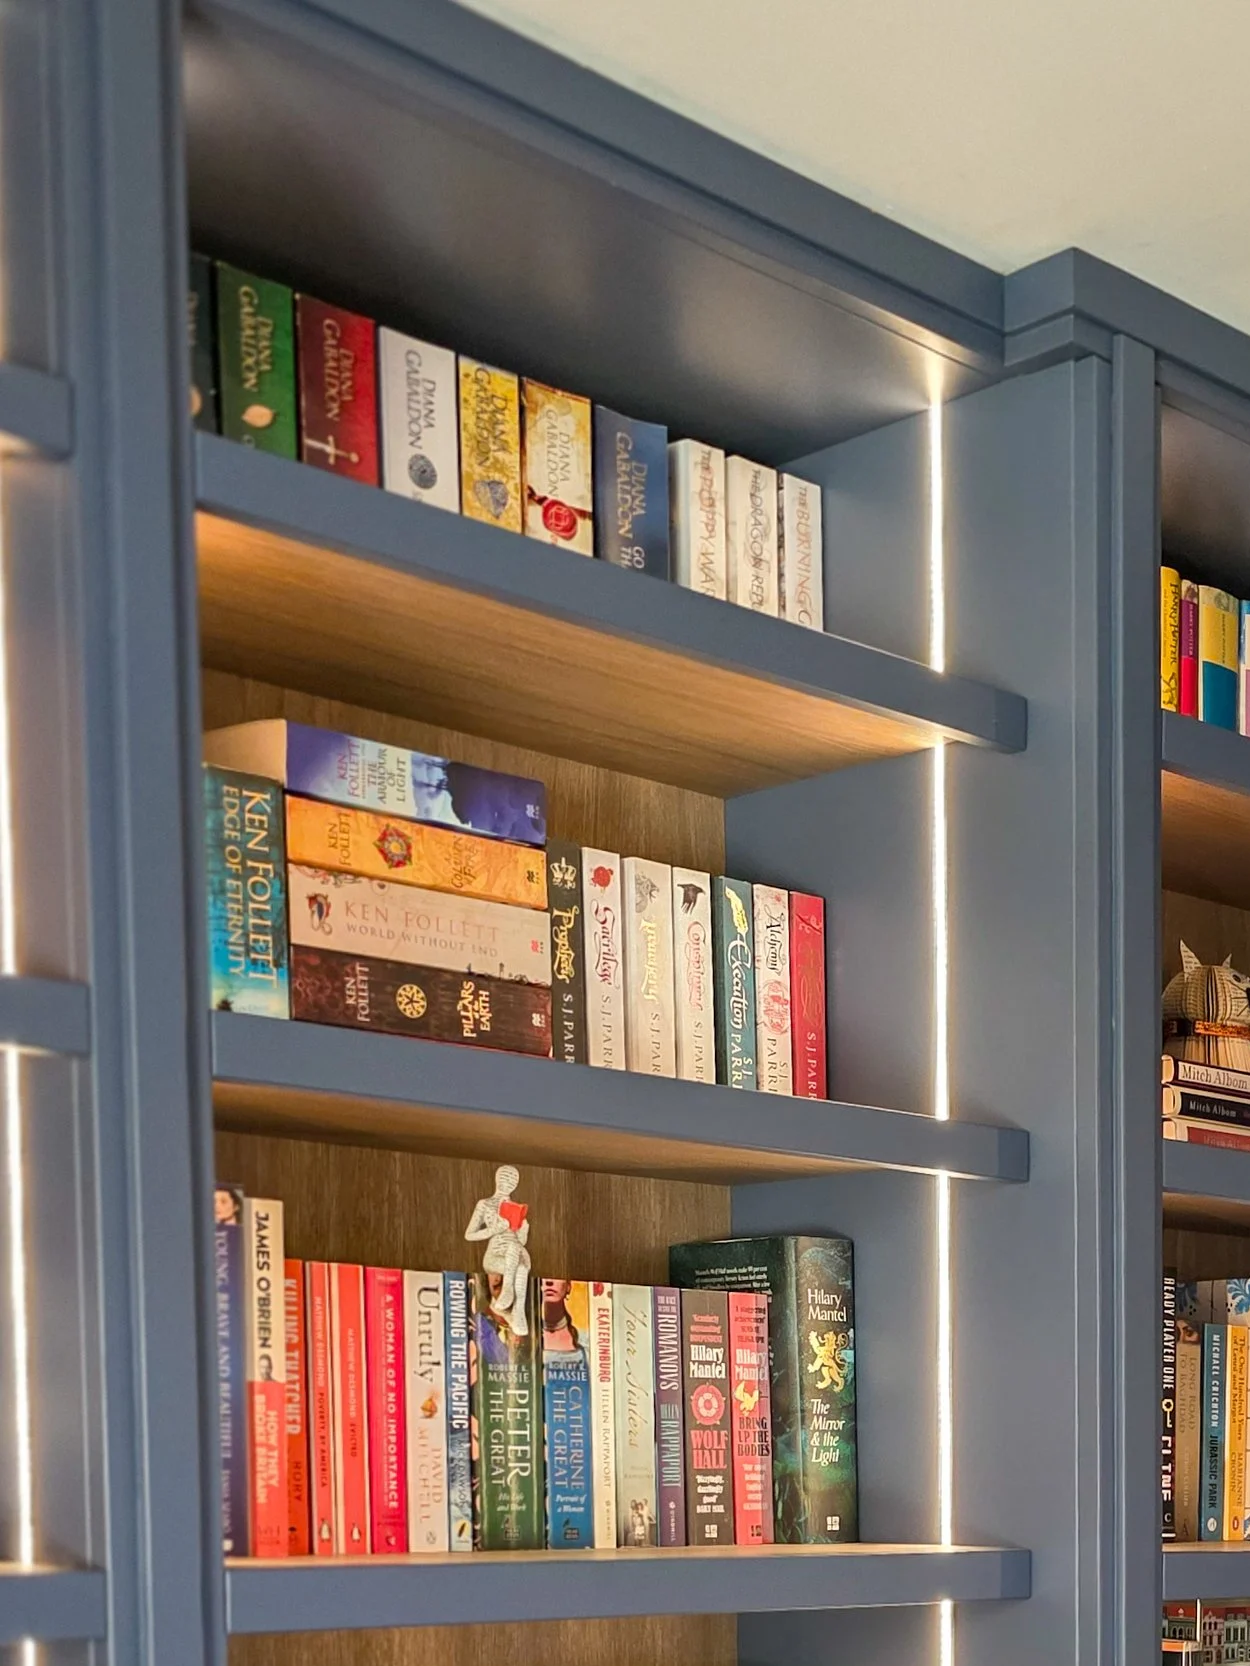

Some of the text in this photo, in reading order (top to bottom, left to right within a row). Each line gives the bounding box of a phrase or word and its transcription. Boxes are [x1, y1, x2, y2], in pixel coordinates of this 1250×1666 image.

[237, 285, 261, 393] GABALDON
[256, 315, 274, 373] DIANA
[322, 317, 341, 422] GABALDON
[340, 346, 356, 404] DIANA
[404, 348, 423, 450] GABALDON
[419, 376, 437, 431] DIANA
[474, 366, 493, 471] GABALDON
[544, 406, 559, 497] GABALDON
[614, 431, 634, 539] GABALDON
[630, 460, 648, 517] DIANA
[222, 784, 247, 979] EDGE ETERNITY
[238, 789, 279, 988] KEN FOLLETT
[345, 900, 501, 943] KEN FOLLETT
[358, 961, 371, 1022] FOLLETT
[255, 1211, 272, 1350] JAMES O'BRIEN
[806, 1288, 843, 1308] Hilary
[416, 1284, 441, 1384] Unruly
[807, 1304, 848, 1323] Mantel
[449, 1279, 469, 1430] ROWING PACIFIC
[488, 1371, 530, 1384] MASSIE
[657, 1312, 679, 1391] ROMANOVS
[506, 1388, 531, 1486] PETER
[568, 1384, 586, 1490] CATHERINE
[809, 1413, 847, 1433] Mirror
[810, 1398, 831, 1415] The
[489, 1428, 505, 1486] GREAT
[553, 1426, 568, 1489] GREAT
[690, 1429, 729, 1451] WOLF
[691, 1447, 729, 1470] HALL
[811, 1446, 841, 1465] Light
